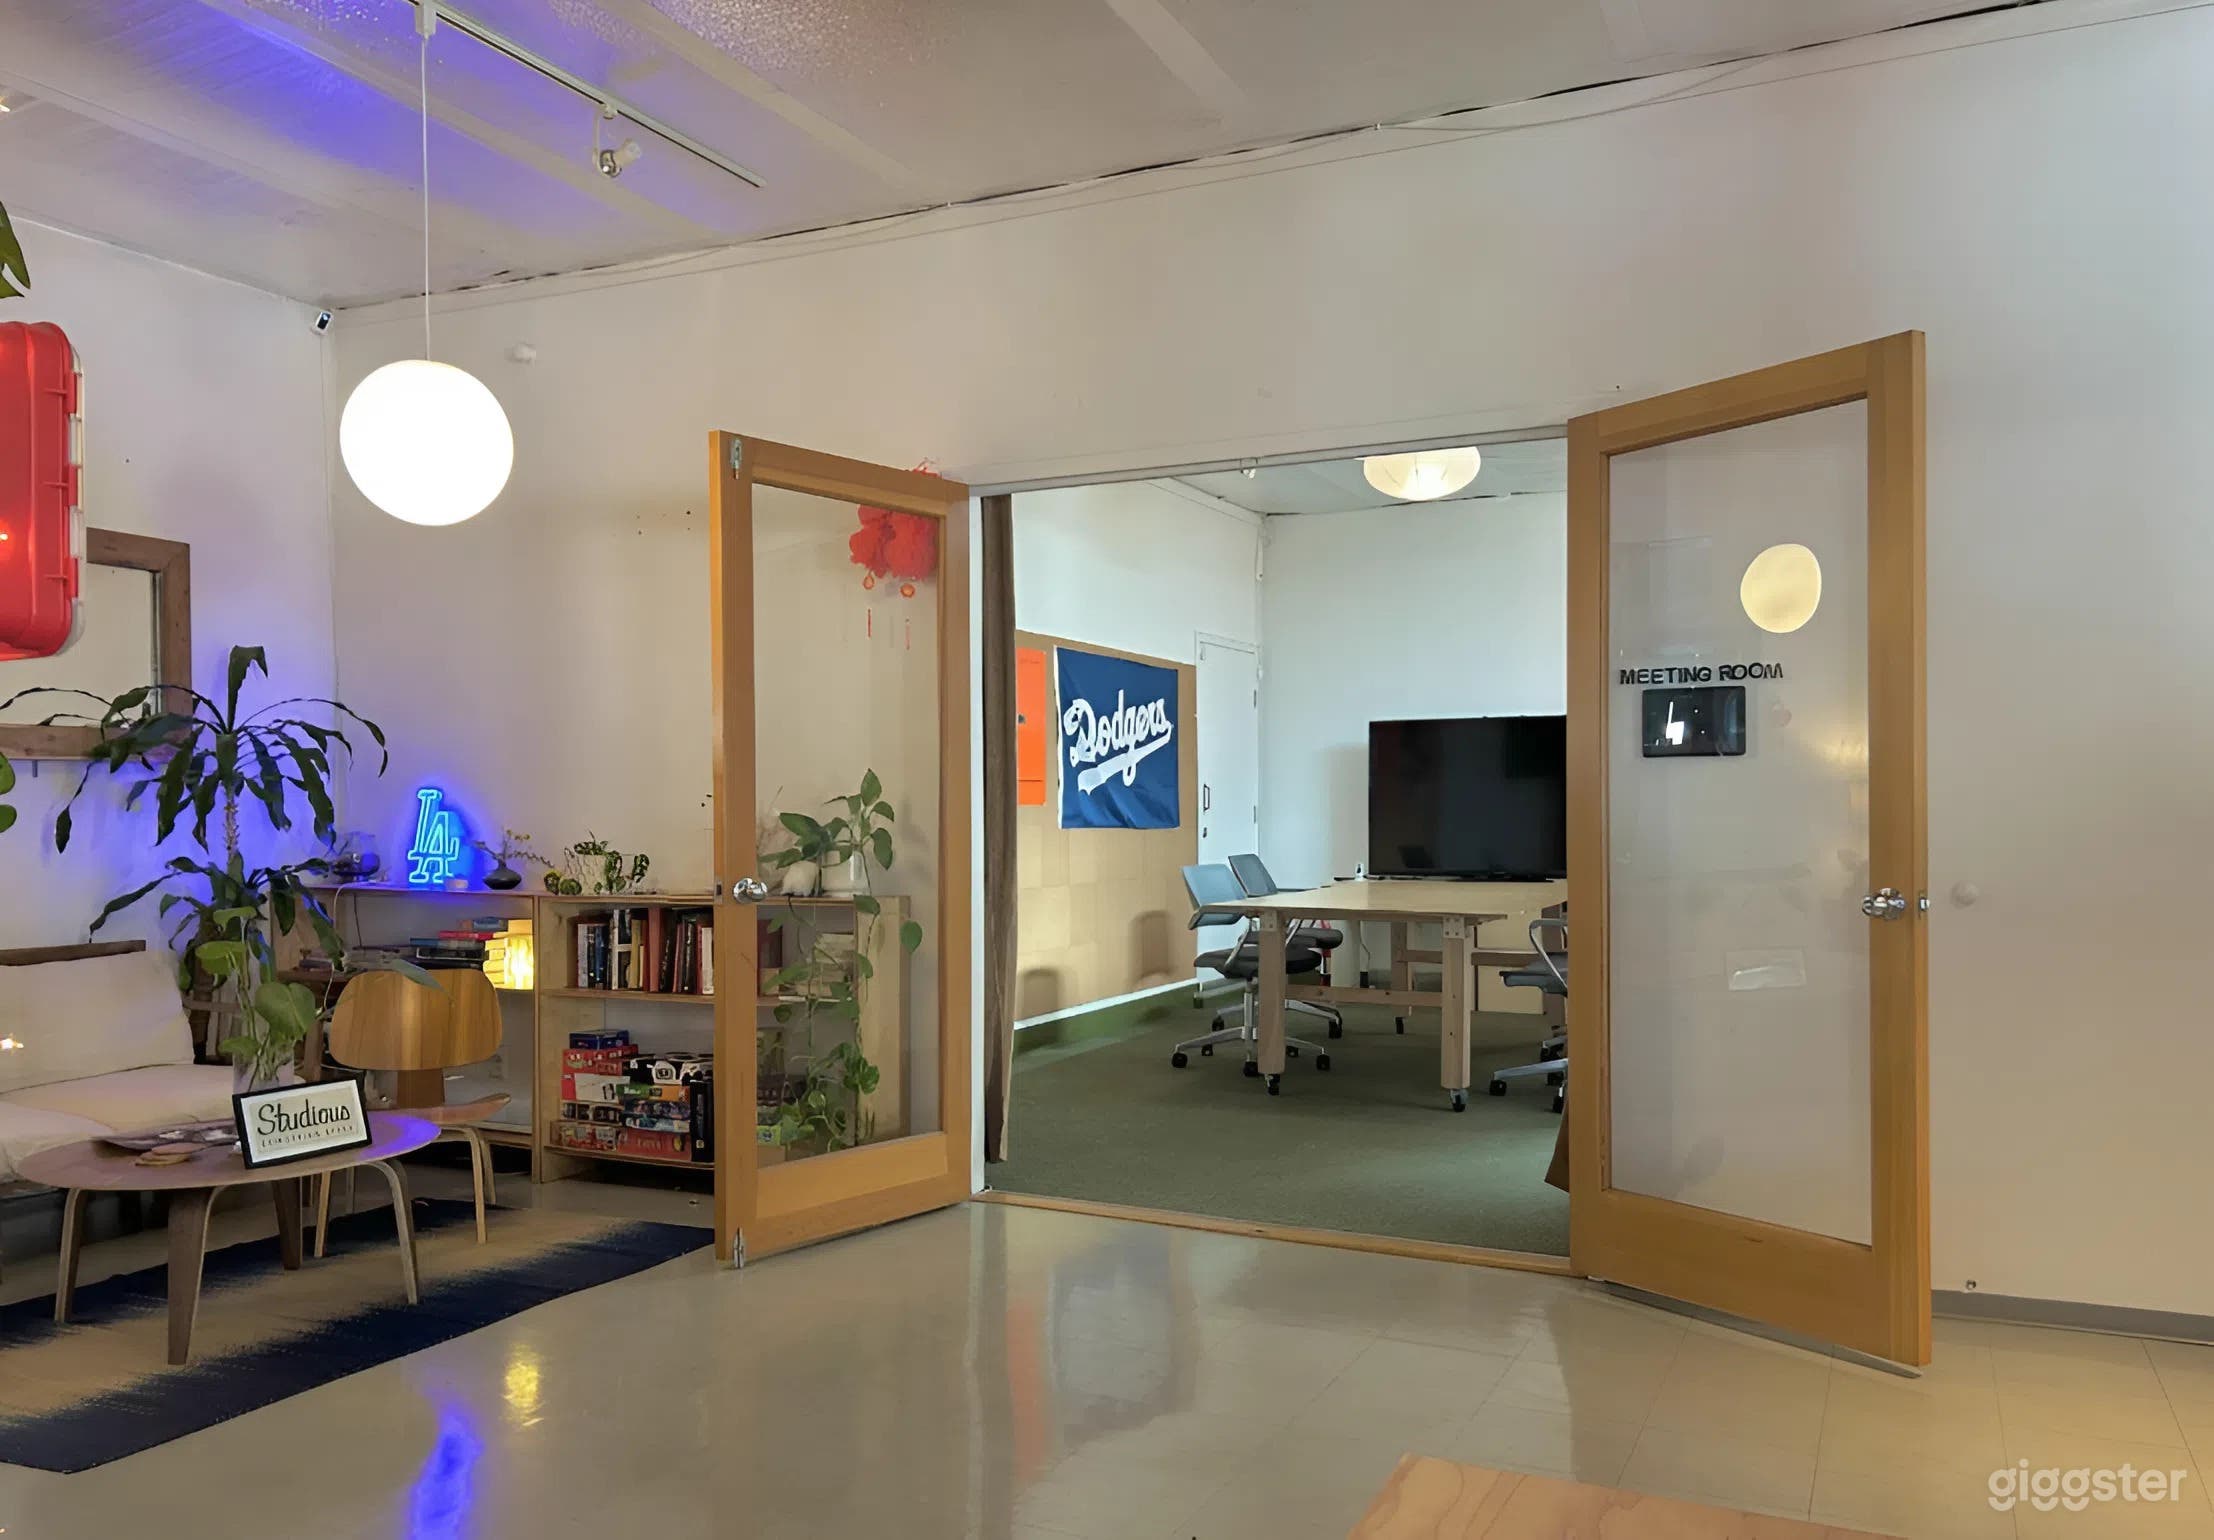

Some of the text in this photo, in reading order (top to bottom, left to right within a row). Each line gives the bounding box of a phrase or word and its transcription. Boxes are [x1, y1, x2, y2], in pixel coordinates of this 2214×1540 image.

[1620, 662, 1784, 685] MEETING ROOM
[1063, 689, 1173, 788] Dodgers
[407, 788, 460, 884] LA
[256, 1098, 351, 1136] Studious
